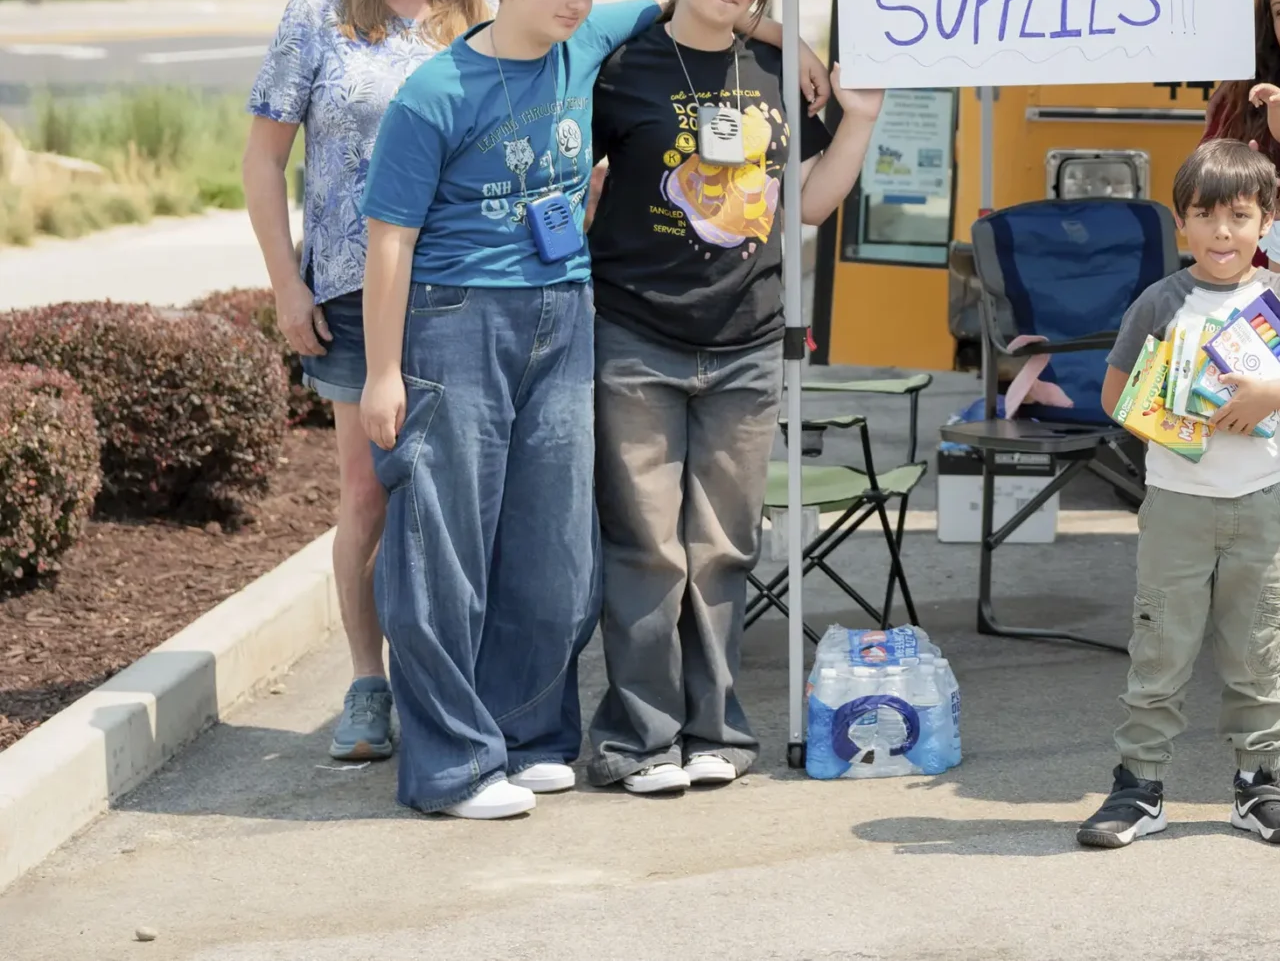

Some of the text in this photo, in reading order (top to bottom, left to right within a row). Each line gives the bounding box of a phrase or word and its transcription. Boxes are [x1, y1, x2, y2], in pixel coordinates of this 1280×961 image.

[477, 119, 519, 154] LEAPING
[518, 100, 564, 125] THROUGH
[482, 180, 512, 197] CNH
[649, 205, 684, 219] TANGLED
[653, 224, 686, 237] SERVICE
[1141, 364, 1168, 411] Crayola
